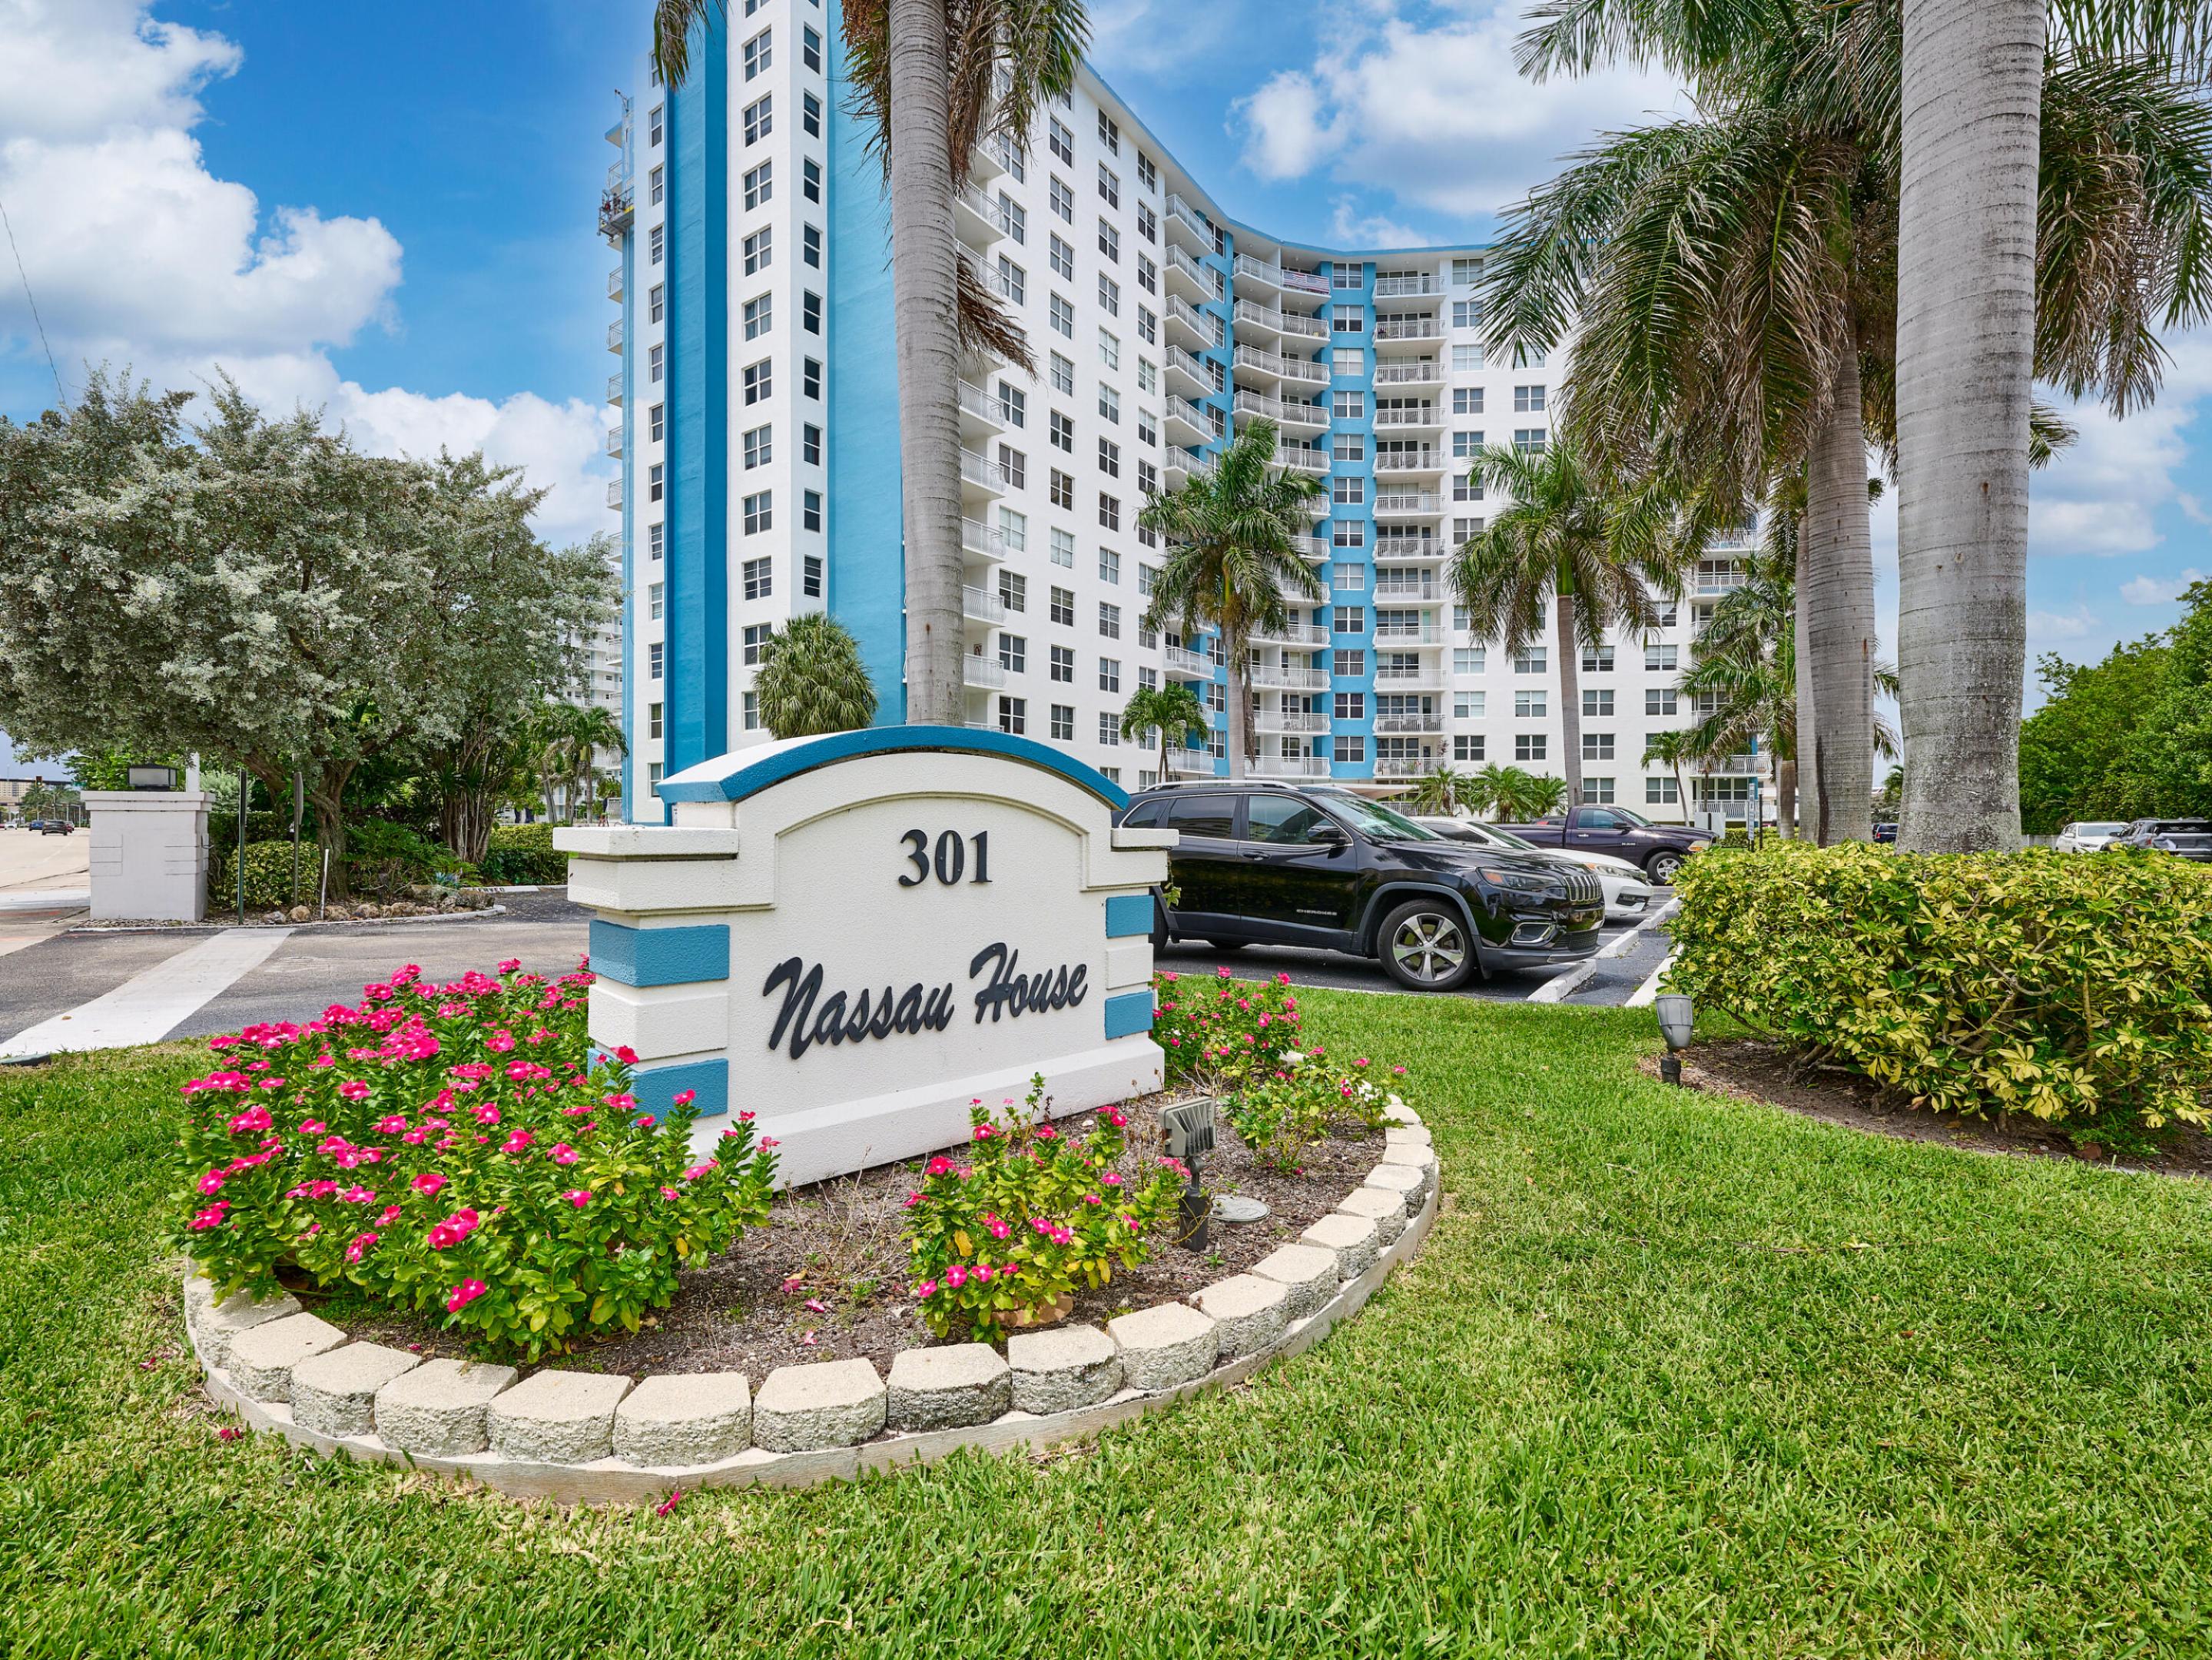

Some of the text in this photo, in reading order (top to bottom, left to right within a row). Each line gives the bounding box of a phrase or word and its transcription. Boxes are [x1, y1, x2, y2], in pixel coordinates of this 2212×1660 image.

[898, 828, 993, 887] 301
[762, 942, 1089, 1061] Nassau House
